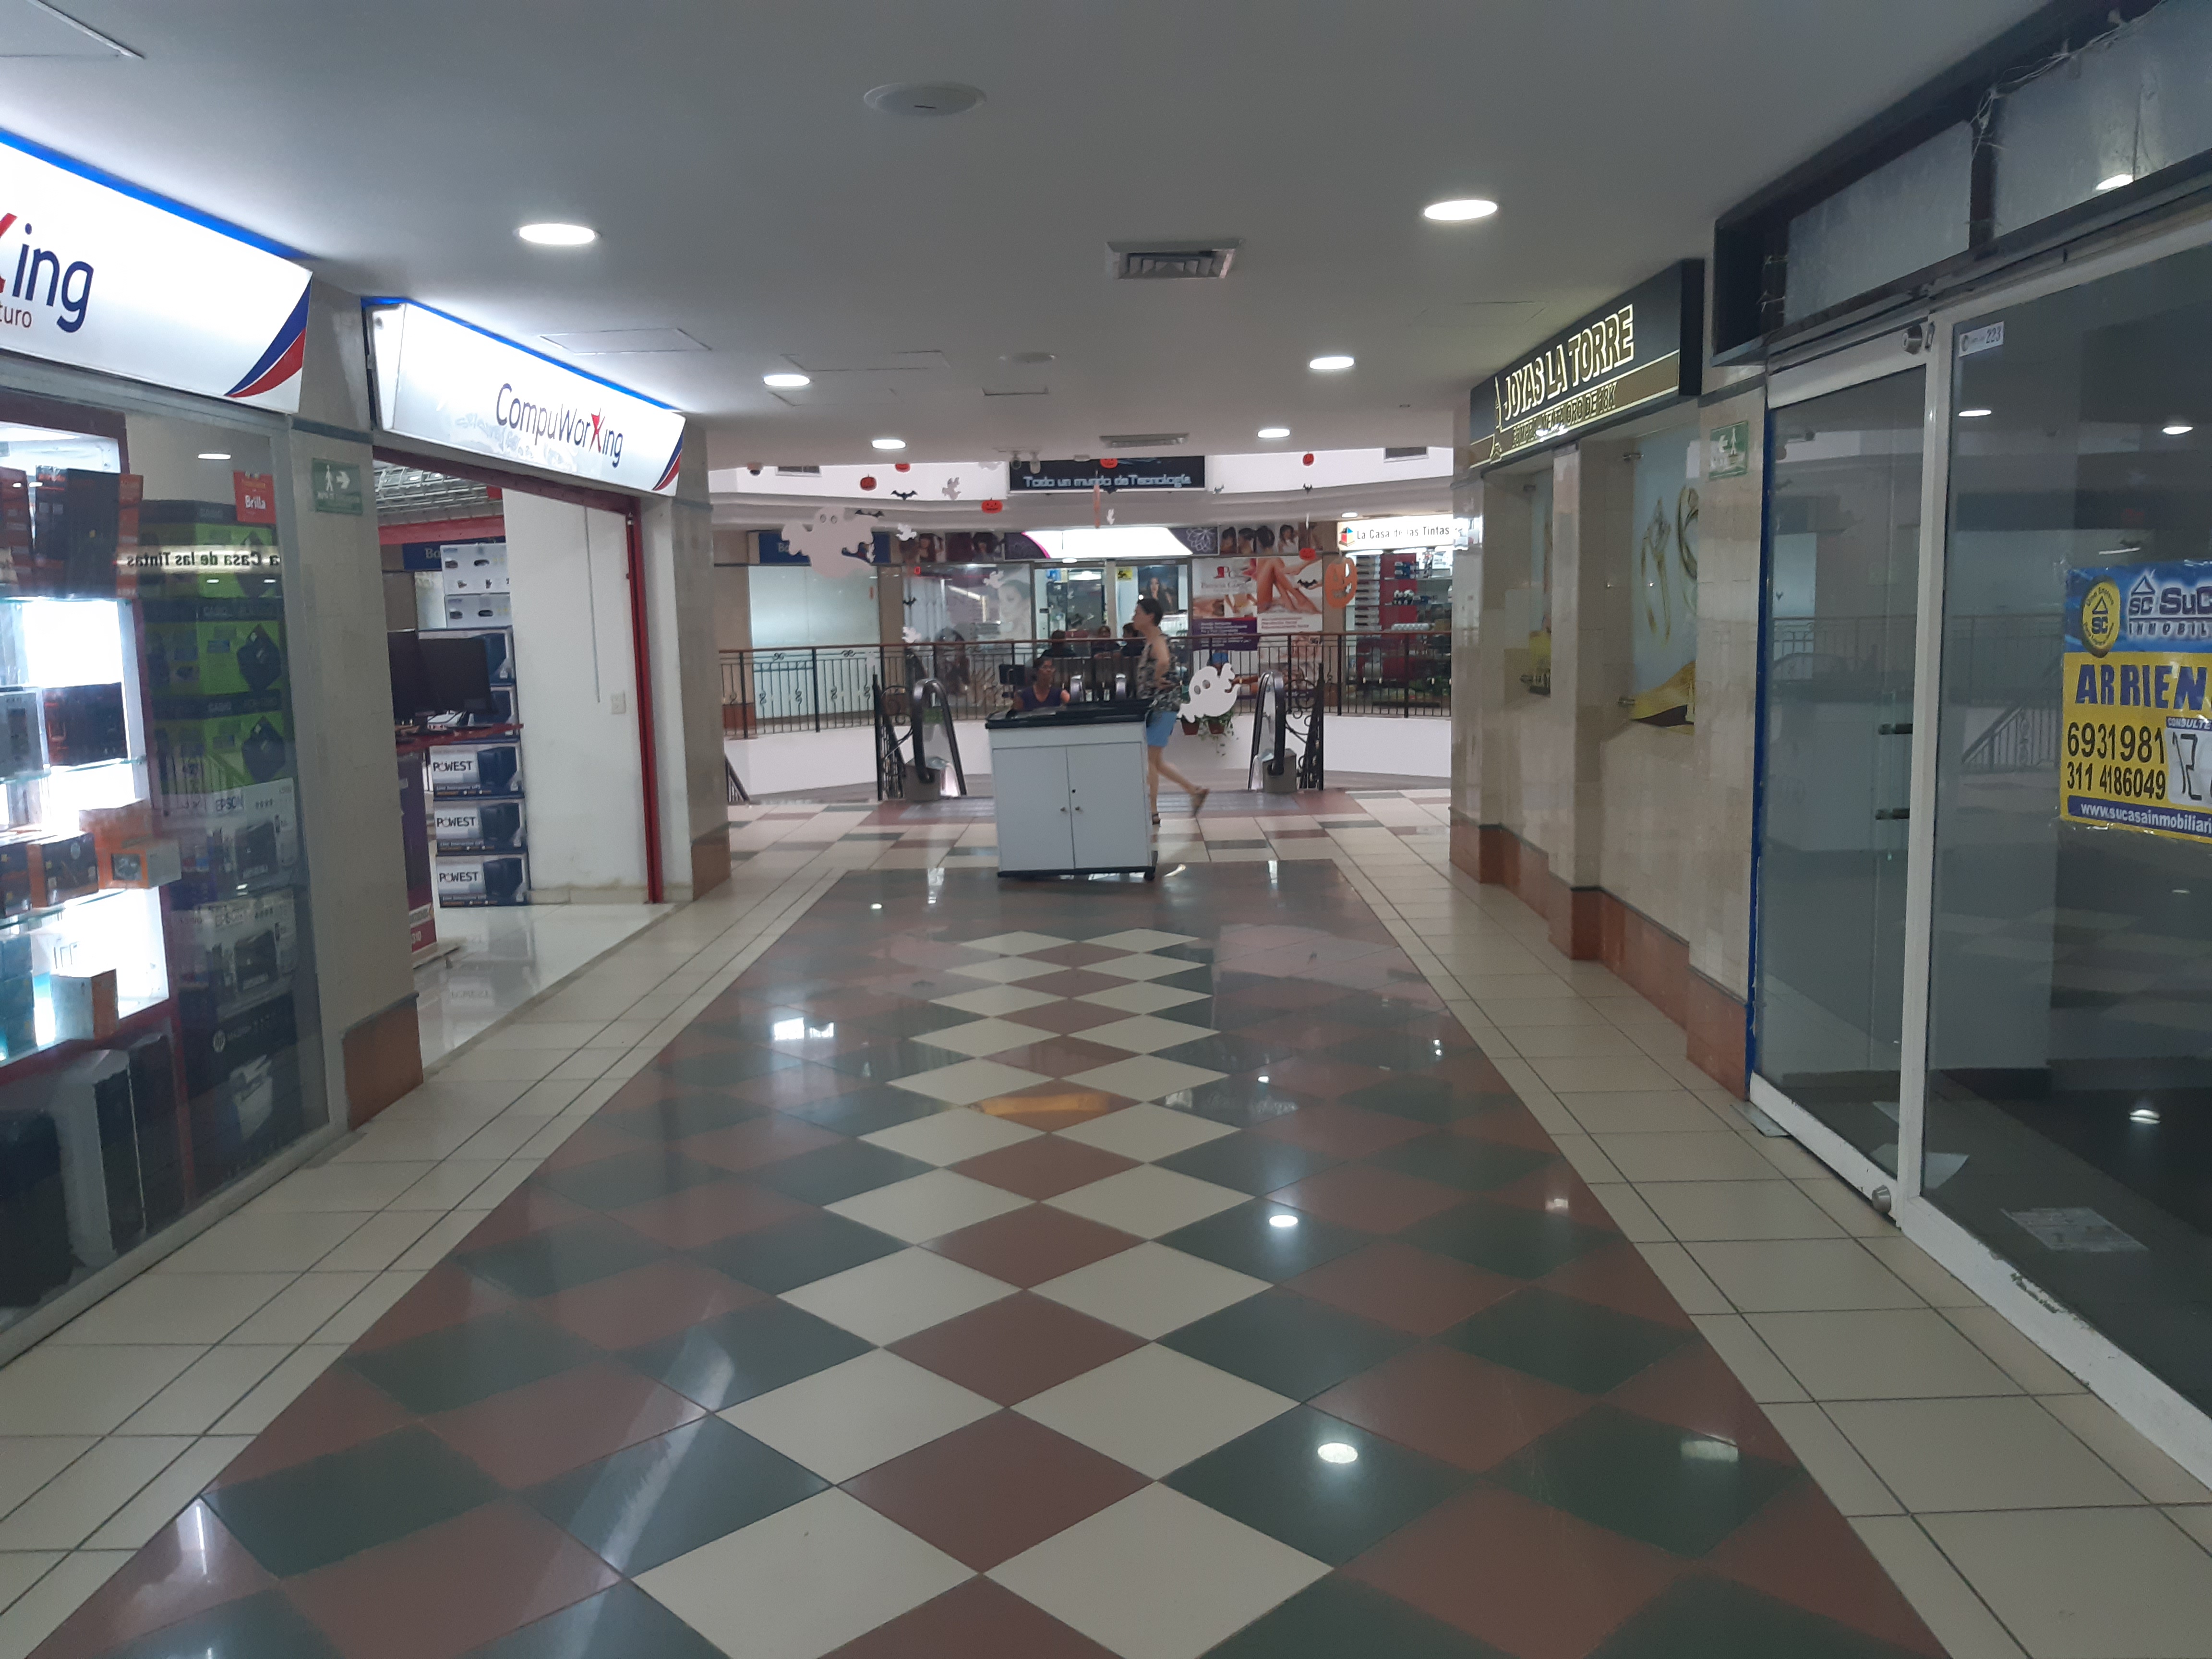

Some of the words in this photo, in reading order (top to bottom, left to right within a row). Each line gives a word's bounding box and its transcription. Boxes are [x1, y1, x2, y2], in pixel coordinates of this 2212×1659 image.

[1986, 326, 2002, 344] 223
[1503, 356, 1545, 421] JOYAS
[1545, 343, 1568, 400] LA
[1567, 303, 1635, 388] TORRE
[1566, 397, 1584, 426] ORO
[1585, 390, 1598, 419] DE
[1598, 381, 1617, 414] 18K
[1023, 475, 1055, 488] Todo
[1058, 479, 1071, 487] un
[1074, 475, 1112, 487] mundo
[1114, 474, 1128, 485] de
[1357, 530, 1366, 540] La
[1370, 529, 1390, 539] Casa
[1422, 526, 1449, 536] Tintas
[2075, 664, 2212, 711] ARRIEN
[2167, 717, 2212, 730] CONSULTE
[2068, 721, 2165, 764] 6931981
[2067, 761, 2093, 792] 311
[2099, 764, 2166, 801] 4186049
[2081, 803, 2212, 834] www.sucasainmobiliari
